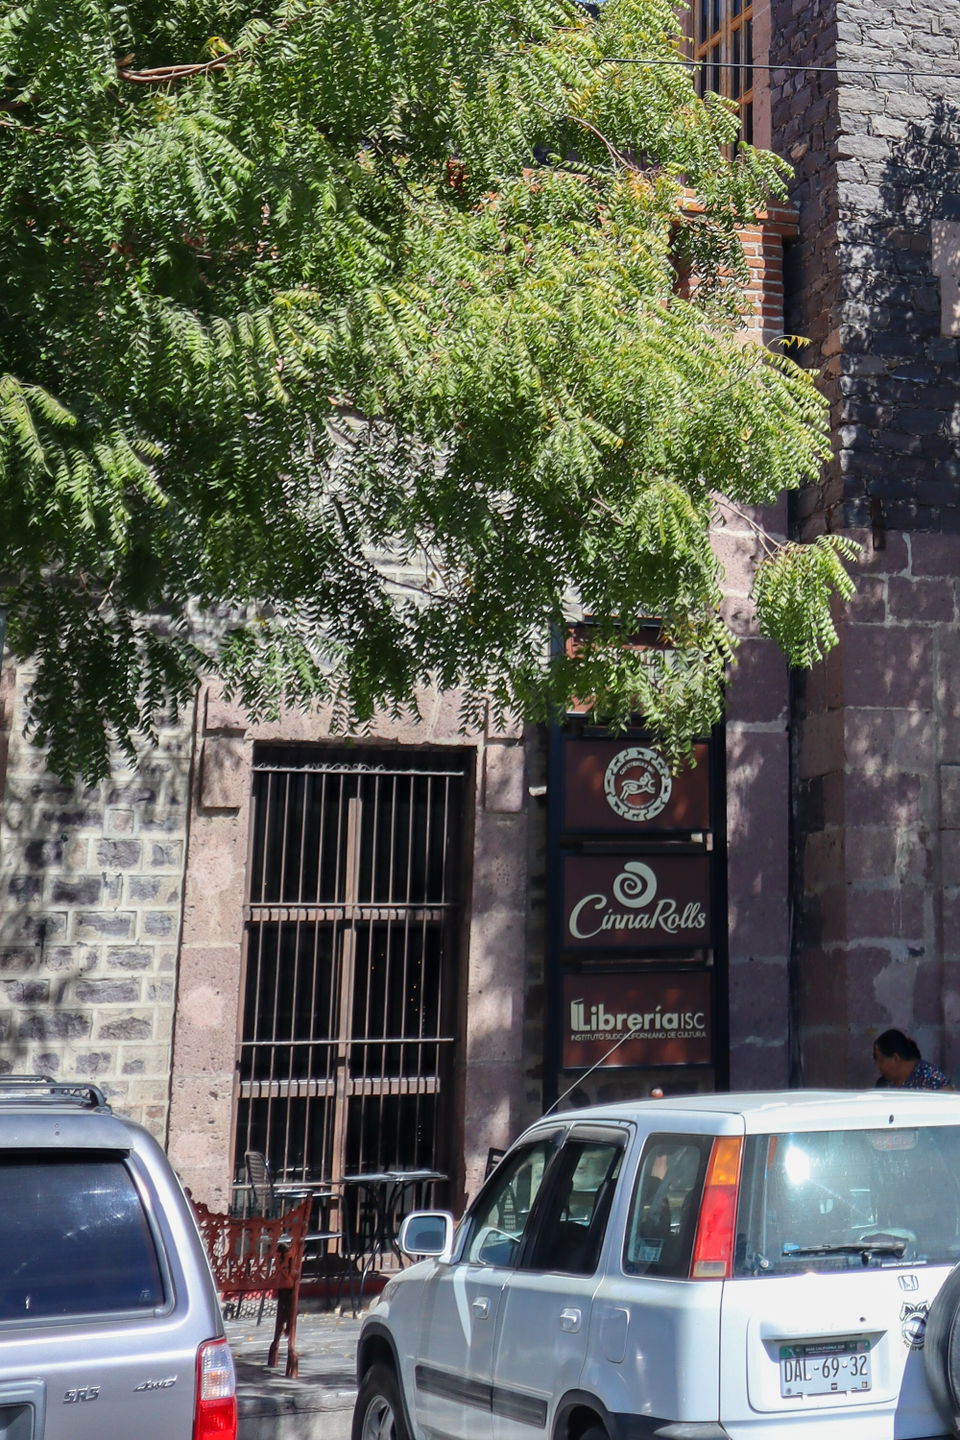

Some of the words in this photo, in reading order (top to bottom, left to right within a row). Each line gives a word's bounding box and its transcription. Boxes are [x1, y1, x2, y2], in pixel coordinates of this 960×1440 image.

[569, 894, 706, 939] CinnaRolls
[571, 999, 679, 1031] Librería
[677, 1031, 706, 1039] CULTURA
[784, 1355, 868, 1383] DAL-69-32
